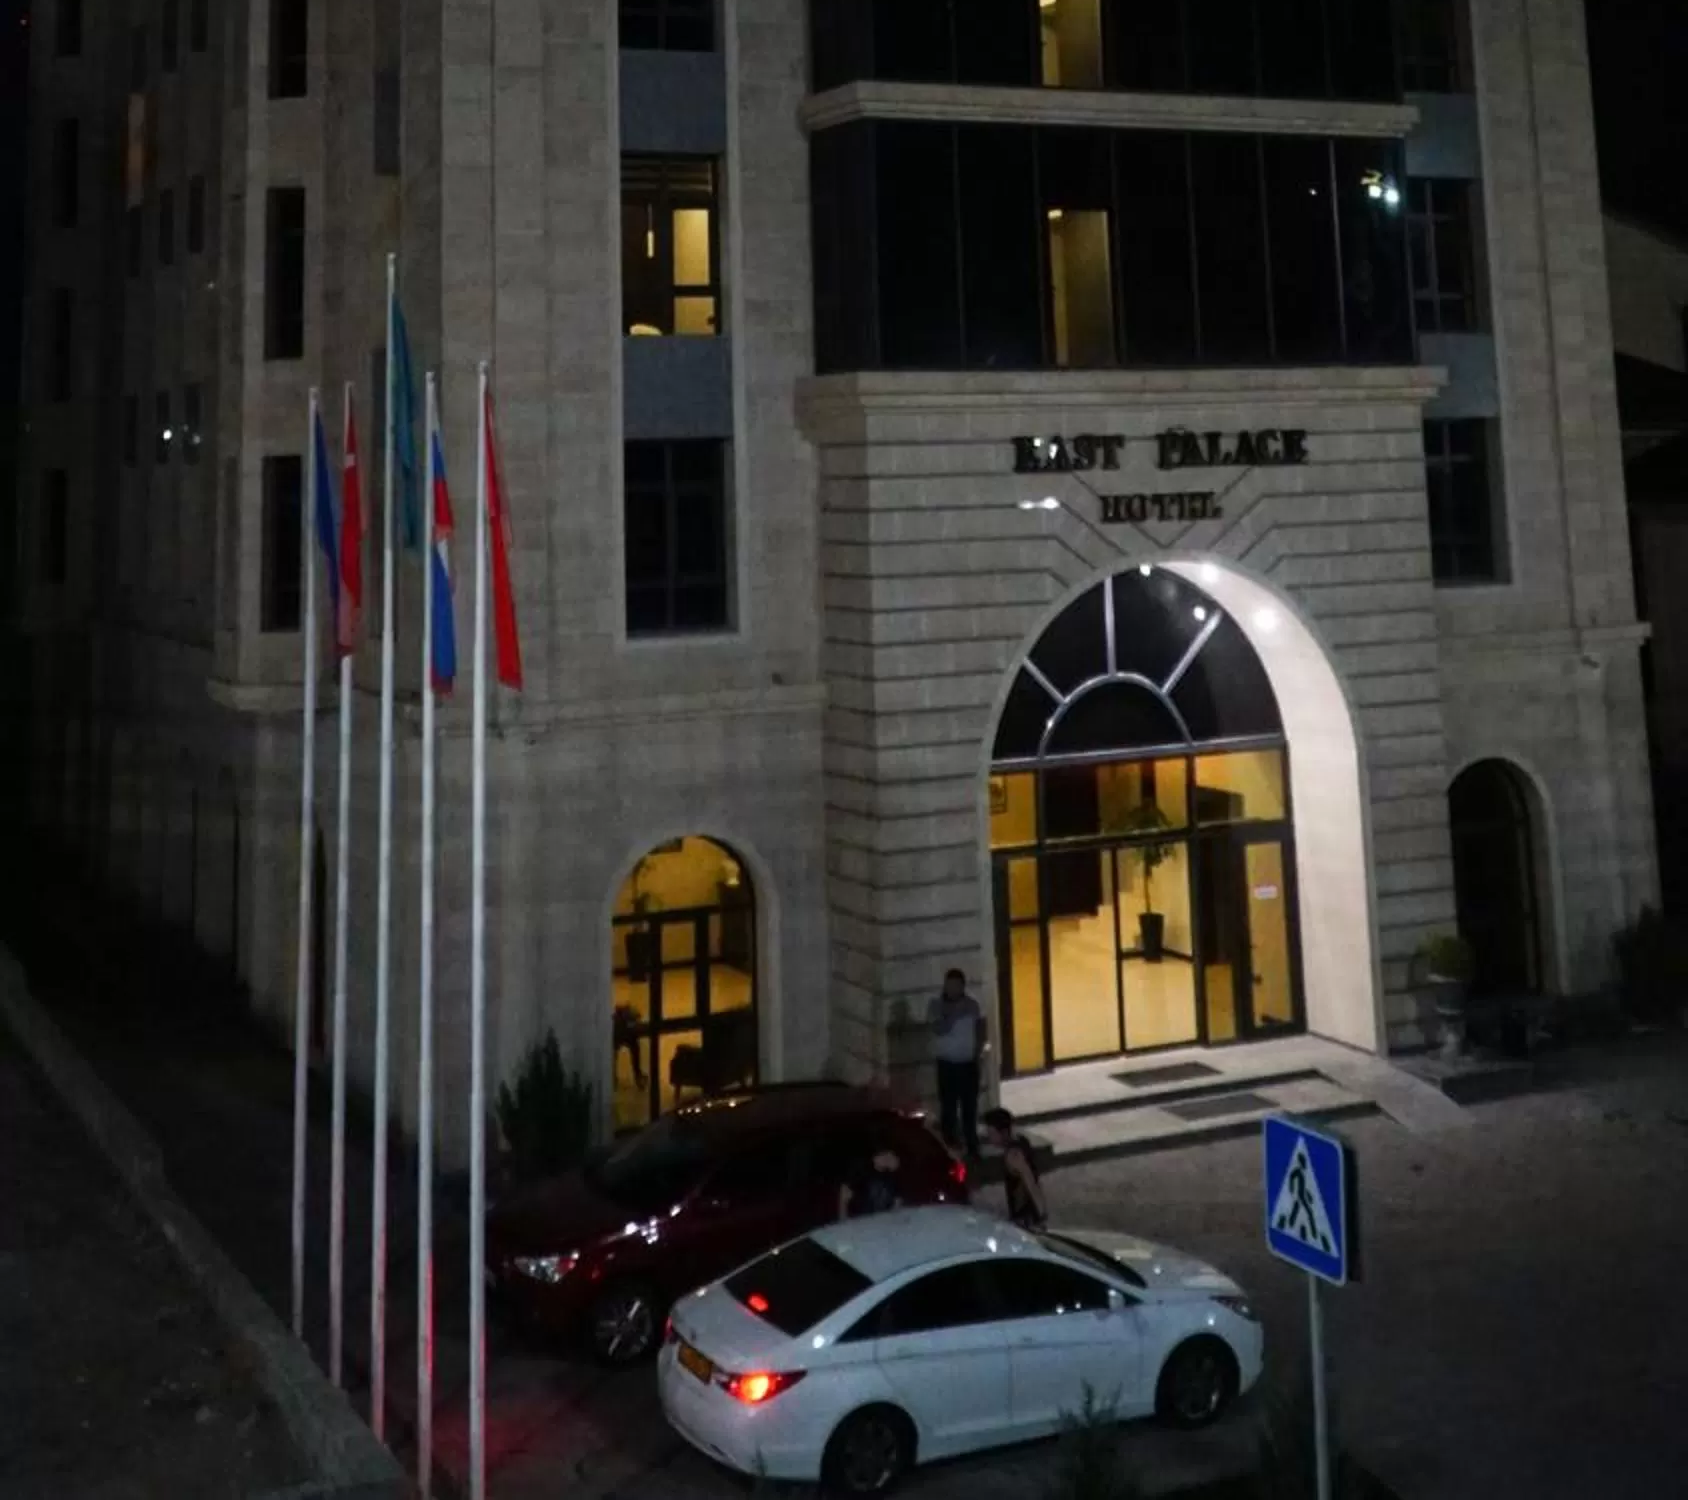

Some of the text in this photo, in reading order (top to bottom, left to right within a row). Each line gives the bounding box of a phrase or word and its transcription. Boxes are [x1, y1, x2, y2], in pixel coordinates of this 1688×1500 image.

[1011, 428, 1309, 474] EAST PALACE
[1099, 490, 1223, 524] HOTEL
